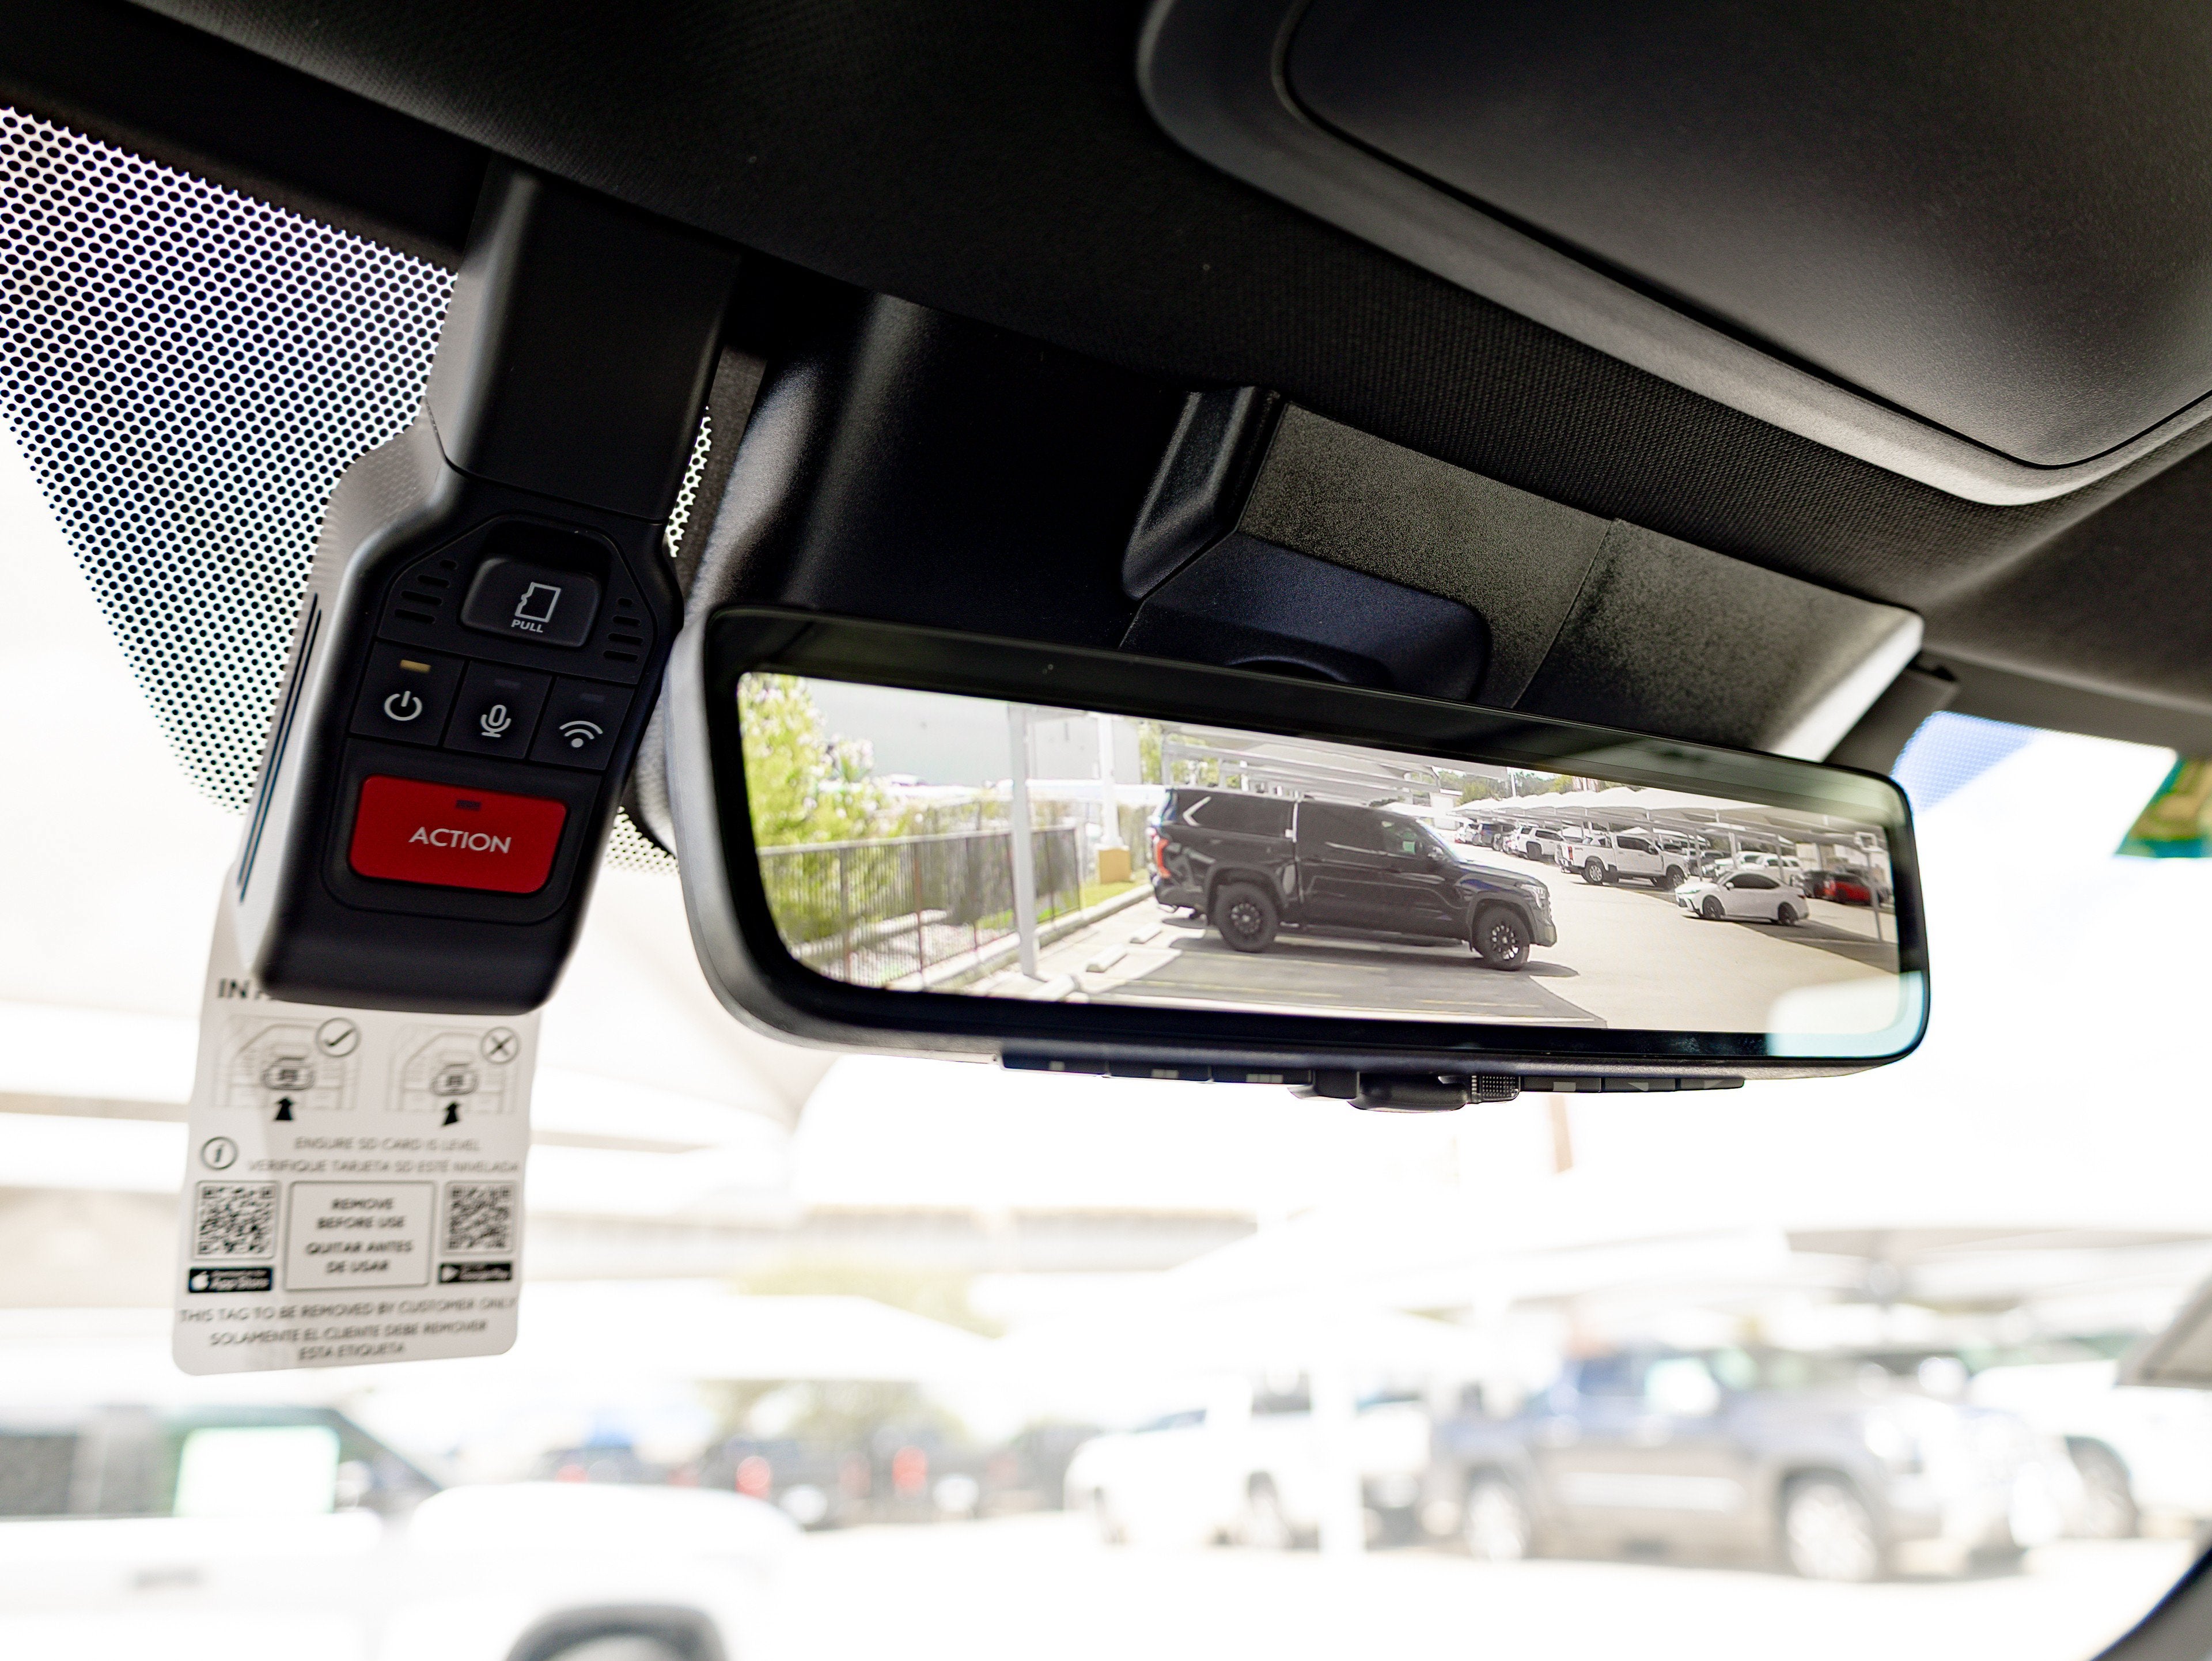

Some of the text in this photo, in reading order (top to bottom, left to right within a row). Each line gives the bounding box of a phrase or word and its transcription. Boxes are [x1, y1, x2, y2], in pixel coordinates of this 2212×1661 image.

[510, 619, 544, 633] PULL
[408, 827, 512, 854] ACTION
[295, 1137, 480, 1151] ENSURE SD CARD IS LEVEL
[249, 1159, 326, 1172] VERIFIQUE
[332, 1159, 389, 1172] TARJETA
[395, 1160, 411, 1173] SD
[331, 1198, 394, 1210] REMOVE
[317, 1216, 406, 1229] BEFORE USE
[305, 1240, 414, 1255] QUITAR ANTES
[326, 1260, 389, 1273] DE USAR
[180, 1297, 517, 1322] THIS TAG TO BE REMOVED BY CUSTOMER ONLY
[210, 1320, 487, 1346] SOLAMENTE EL CLIENTE DEBE REMOVER
[298, 1342, 405, 1360] ESTA ETIQUETA
